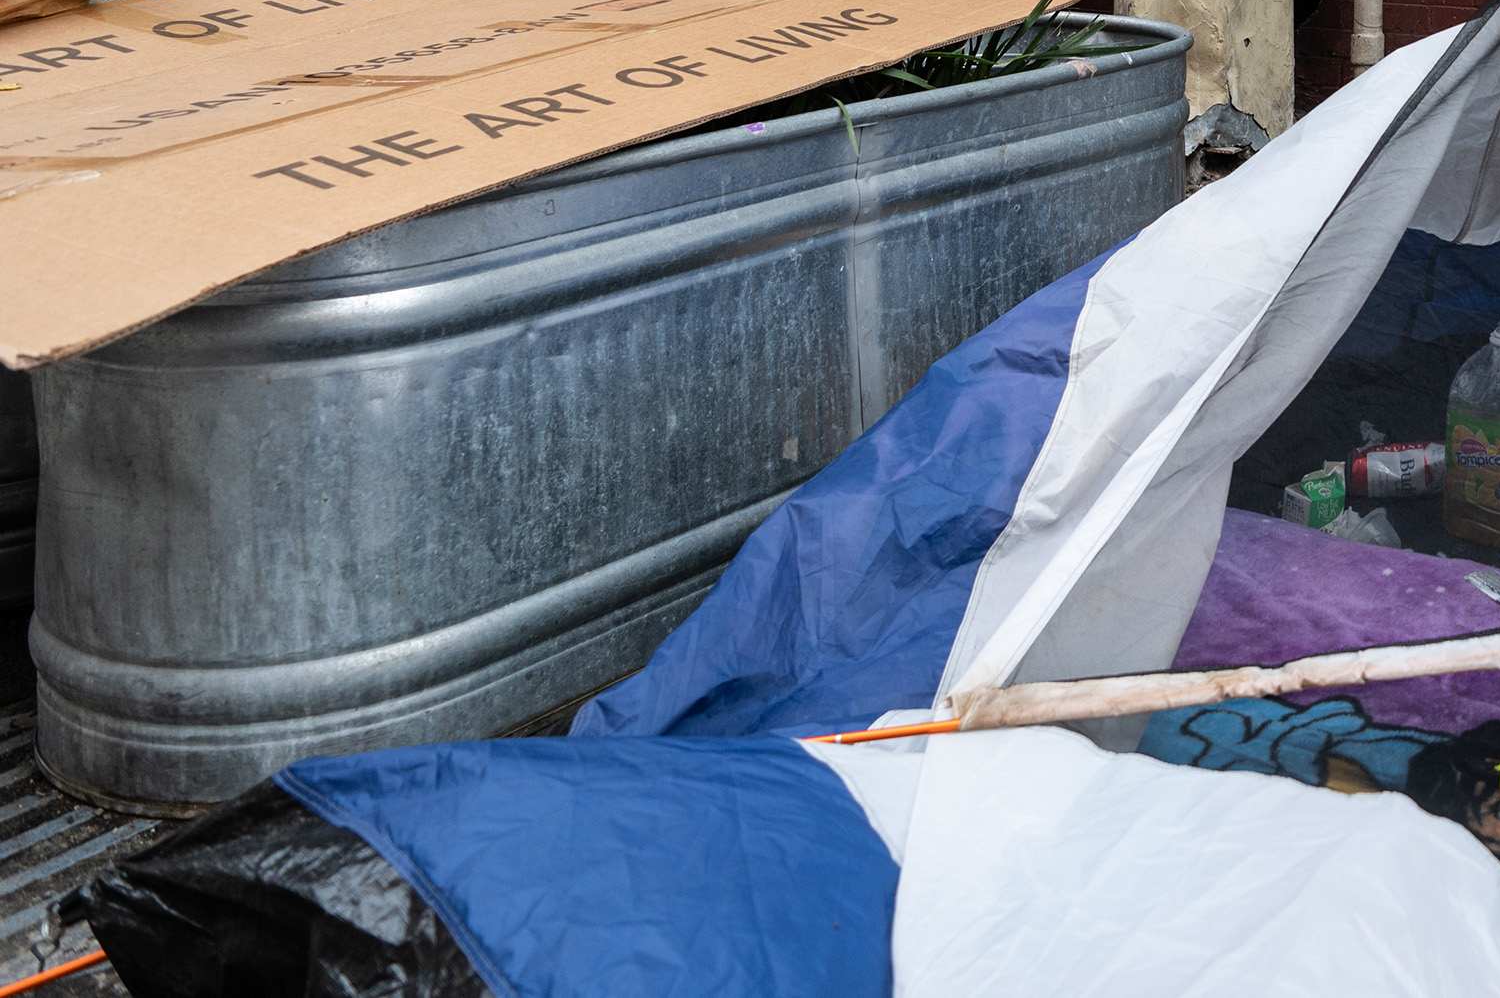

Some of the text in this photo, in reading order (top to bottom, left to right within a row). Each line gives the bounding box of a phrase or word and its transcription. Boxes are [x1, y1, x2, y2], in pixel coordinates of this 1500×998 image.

[152, 8, 253, 39] OF
[252, 8, 899, 190] THE ART OF LIVING
[1370, 443, 1424, 453] ENUINE
